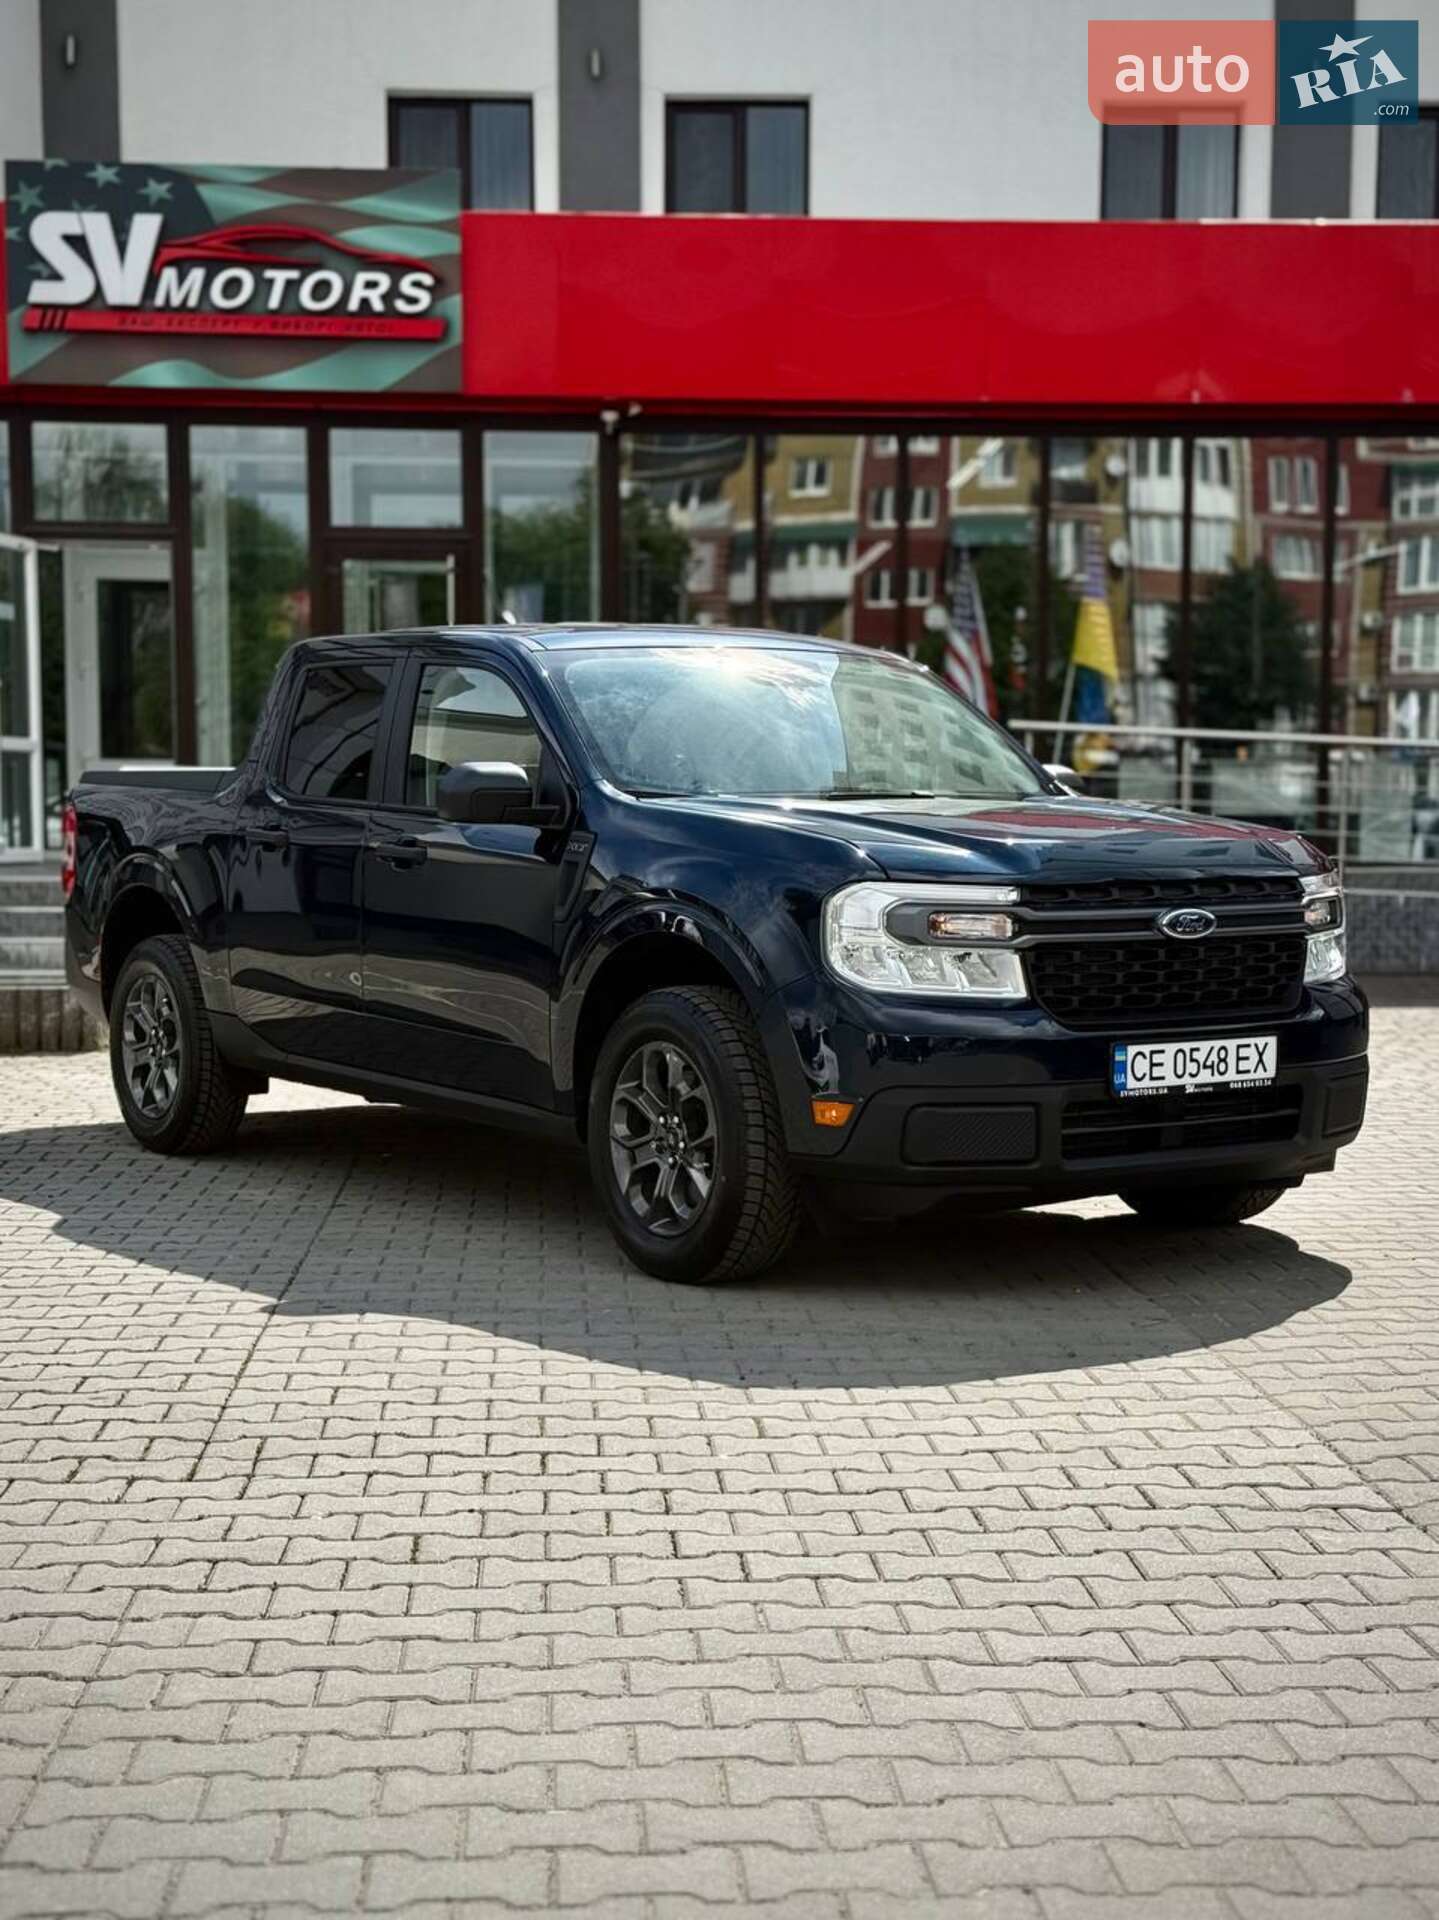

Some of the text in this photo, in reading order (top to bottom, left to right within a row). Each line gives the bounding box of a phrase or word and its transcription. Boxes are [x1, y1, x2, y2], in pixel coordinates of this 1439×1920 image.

[28, 210, 436, 315] SV MOTORS
[1176, 914, 1206, 932] Ford
[1131, 1042, 1269, 1082] CE 0548 EX
[1114, 1072, 1126, 1084] UA
